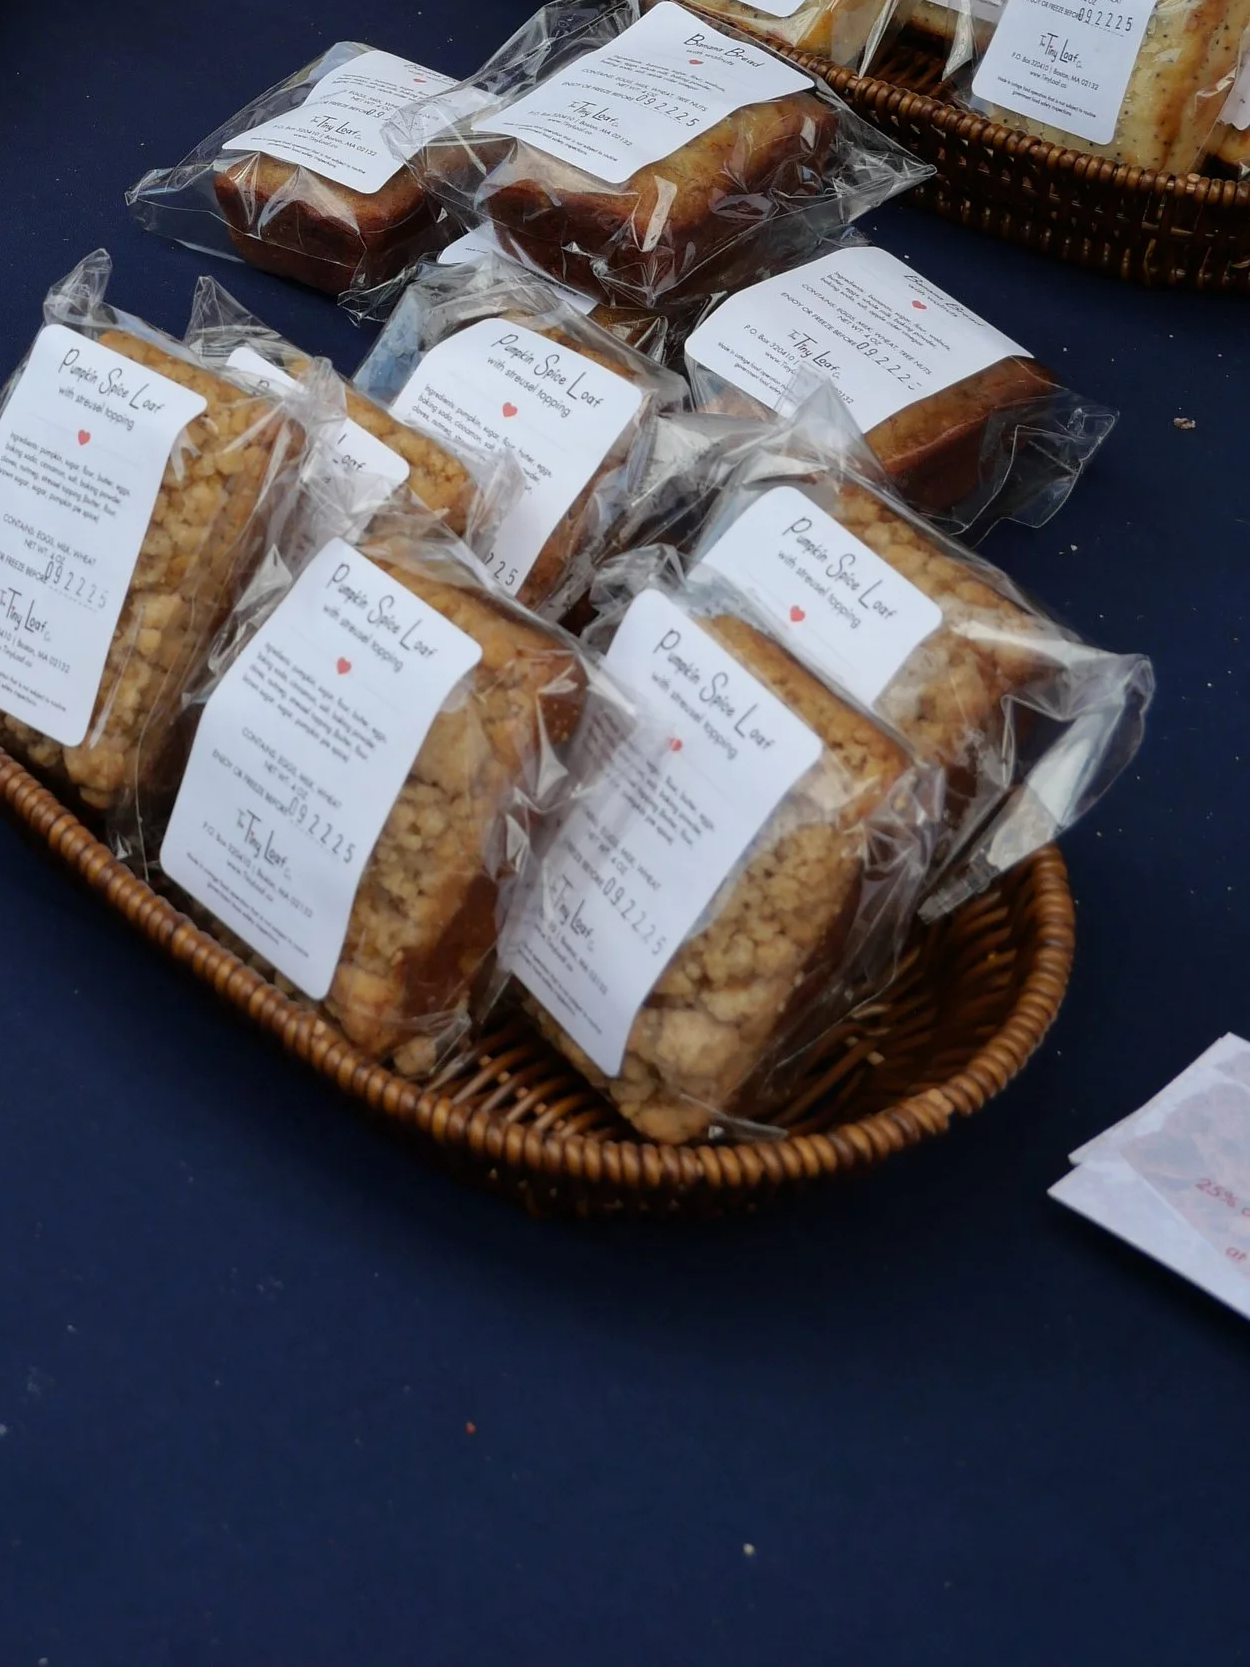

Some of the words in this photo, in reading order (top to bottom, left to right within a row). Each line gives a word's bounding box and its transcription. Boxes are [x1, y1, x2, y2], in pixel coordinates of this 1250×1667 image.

[1078, 7, 1133, 32] 092225
[684, 33, 724, 53] Banana
[724, 47, 765, 68] Bread
[1045, 32, 1059, 63] Tiny
[1060, 38, 1079, 64] Loaf
[1071, 74, 1081, 83] MA
[1081, 78, 1099, 91] 02132
[317, 115, 337, 133] Tiny
[335, 122, 360, 136] Loaf
[574, 101, 597, 119] Tiny
[592, 107, 616, 123] Loaf
[635, 94, 700, 127] 092225
[780, 292, 803, 309] ENJOY
[803, 306, 813, 315] OR
[812, 314, 834, 332] FREEZE
[833, 329, 857, 347] BEFORE
[744, 325, 756, 335] P.O.
[757, 332, 770, 343] Box
[770, 341, 795, 361] 320410
[794, 333, 817, 358] Tiny
[813, 351, 839, 372] Loaf
[899, 350, 915, 364] TREE
[914, 359, 932, 375] NUTS
[58, 348, 98, 384] Pumpkin
[99, 368, 130, 398] Spice
[129, 384, 165, 414] Loaf
[487, 356, 505, 372] with
[504, 369, 539, 392] streusel
[536, 389, 571, 418] topping
[491, 334, 535, 365] Pumpkin
[533, 354, 567, 385] Spice
[566, 371, 605, 408] Loaf
[58, 386, 74, 399] with
[75, 394, 103, 413] streusel
[104, 407, 134, 431] topping
[44, 561, 109, 609] 092225
[782, 516, 828, 563] Pumpkin
[825, 553, 861, 591] Spice
[858, 579, 898, 619] Loaf
[6, 587, 23, 631] Tiny
[24, 599, 48, 633] Loaf
[326, 563, 368, 609] Pumpkin
[367, 595, 401, 634] Spice
[399, 619, 438, 658] Loaf
[828, 593, 861, 629] topping
[652, 628, 700, 685] Pumpkin
[699, 672, 735, 717] Spice
[734, 703, 776, 750] Loaf
[264, 830, 288, 866] Loaf
[288, 796, 356, 864] 092225
[570, 898, 594, 938] Loaf
[602, 877, 666, 956] 092225
[1194, 1178, 1237, 1208] 25%
